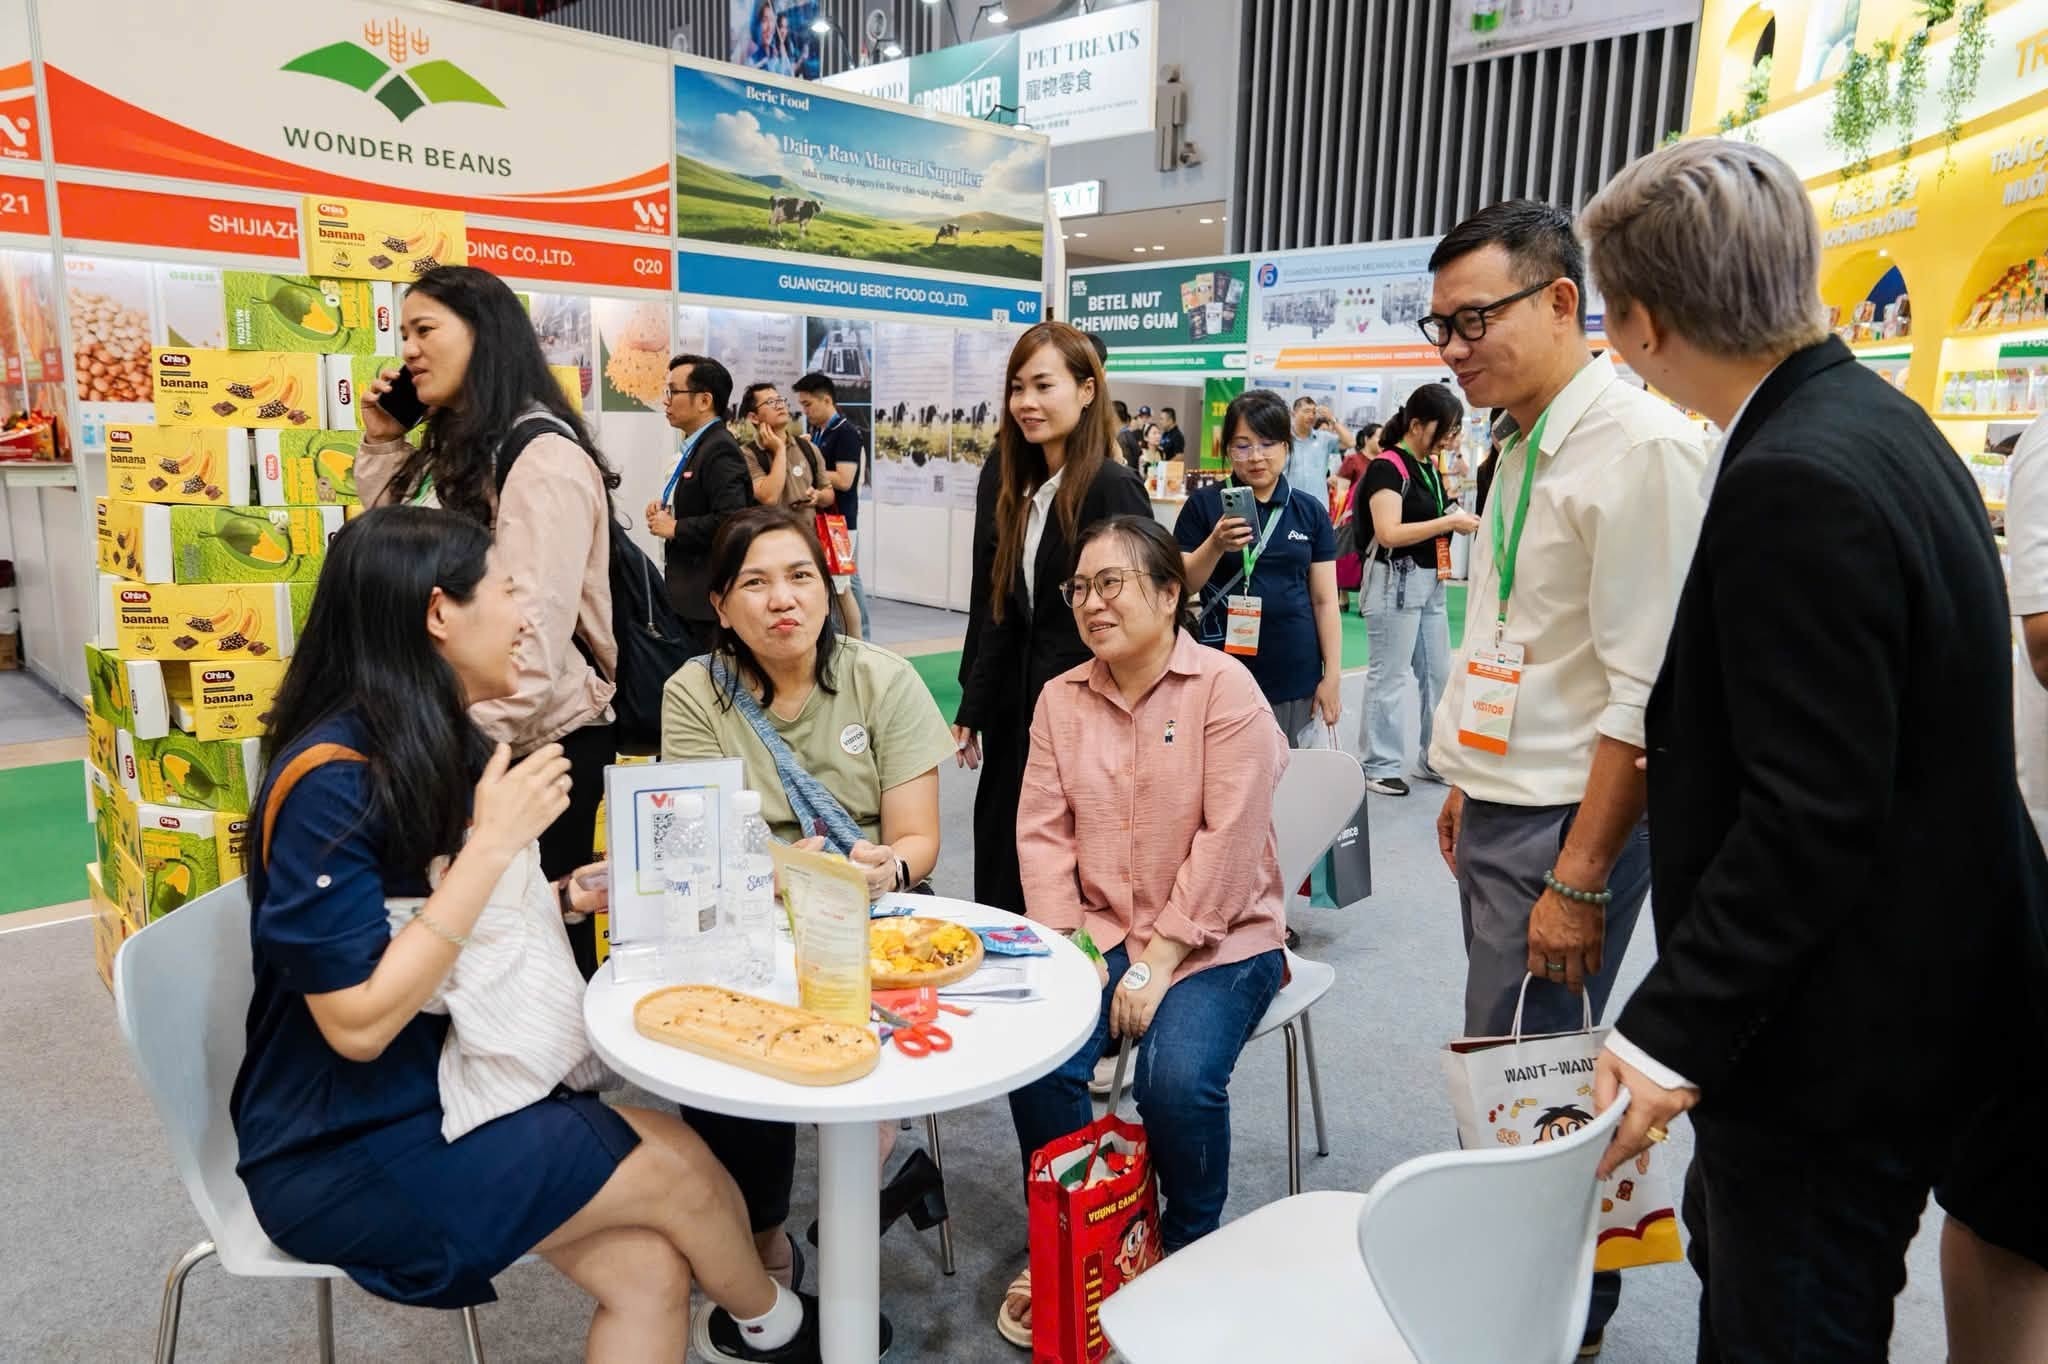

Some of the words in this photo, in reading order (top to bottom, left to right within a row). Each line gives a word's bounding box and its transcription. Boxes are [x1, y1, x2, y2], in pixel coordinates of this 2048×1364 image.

[1027, 46, 1061, 70] PET
[1065, 28, 1140, 61] TREATS
[746, 86, 778, 105] Beric
[780, 92, 809, 112] Food
[283, 125, 414, 165] WONDER
[424, 147, 512, 177] BEANS
[783, 135, 824, 163] Dairy
[829, 143, 861, 165] Raw
[864, 150, 924, 178] Material
[926, 160, 983, 188] Supplier
[0, 193, 30, 215] 21
[319, 227, 365, 241] banana
[512, 245, 576, 267] CO.,LTD.
[633, 257, 663, 275] Q20
[778, 275, 857, 295] GUANGZHOU
[860, 283, 893, 300] BERIC
[895, 286, 926, 302] FOOD
[928, 290, 969, 307] CO.,LTD.
[1088, 293, 1128, 311] BETEL
[1131, 291, 1162, 308] NUT
[1017, 300, 1036, 315] Q19
[1072, 314, 1140, 333] CHEWING
[1142, 311, 1178, 329] GUM
[160, 377, 208, 389] banana
[110, 453, 146, 464] banana
[122, 614, 169, 624] banana
[203, 693, 254, 704] banana
[1472, 700, 1505, 715] VISITOR
